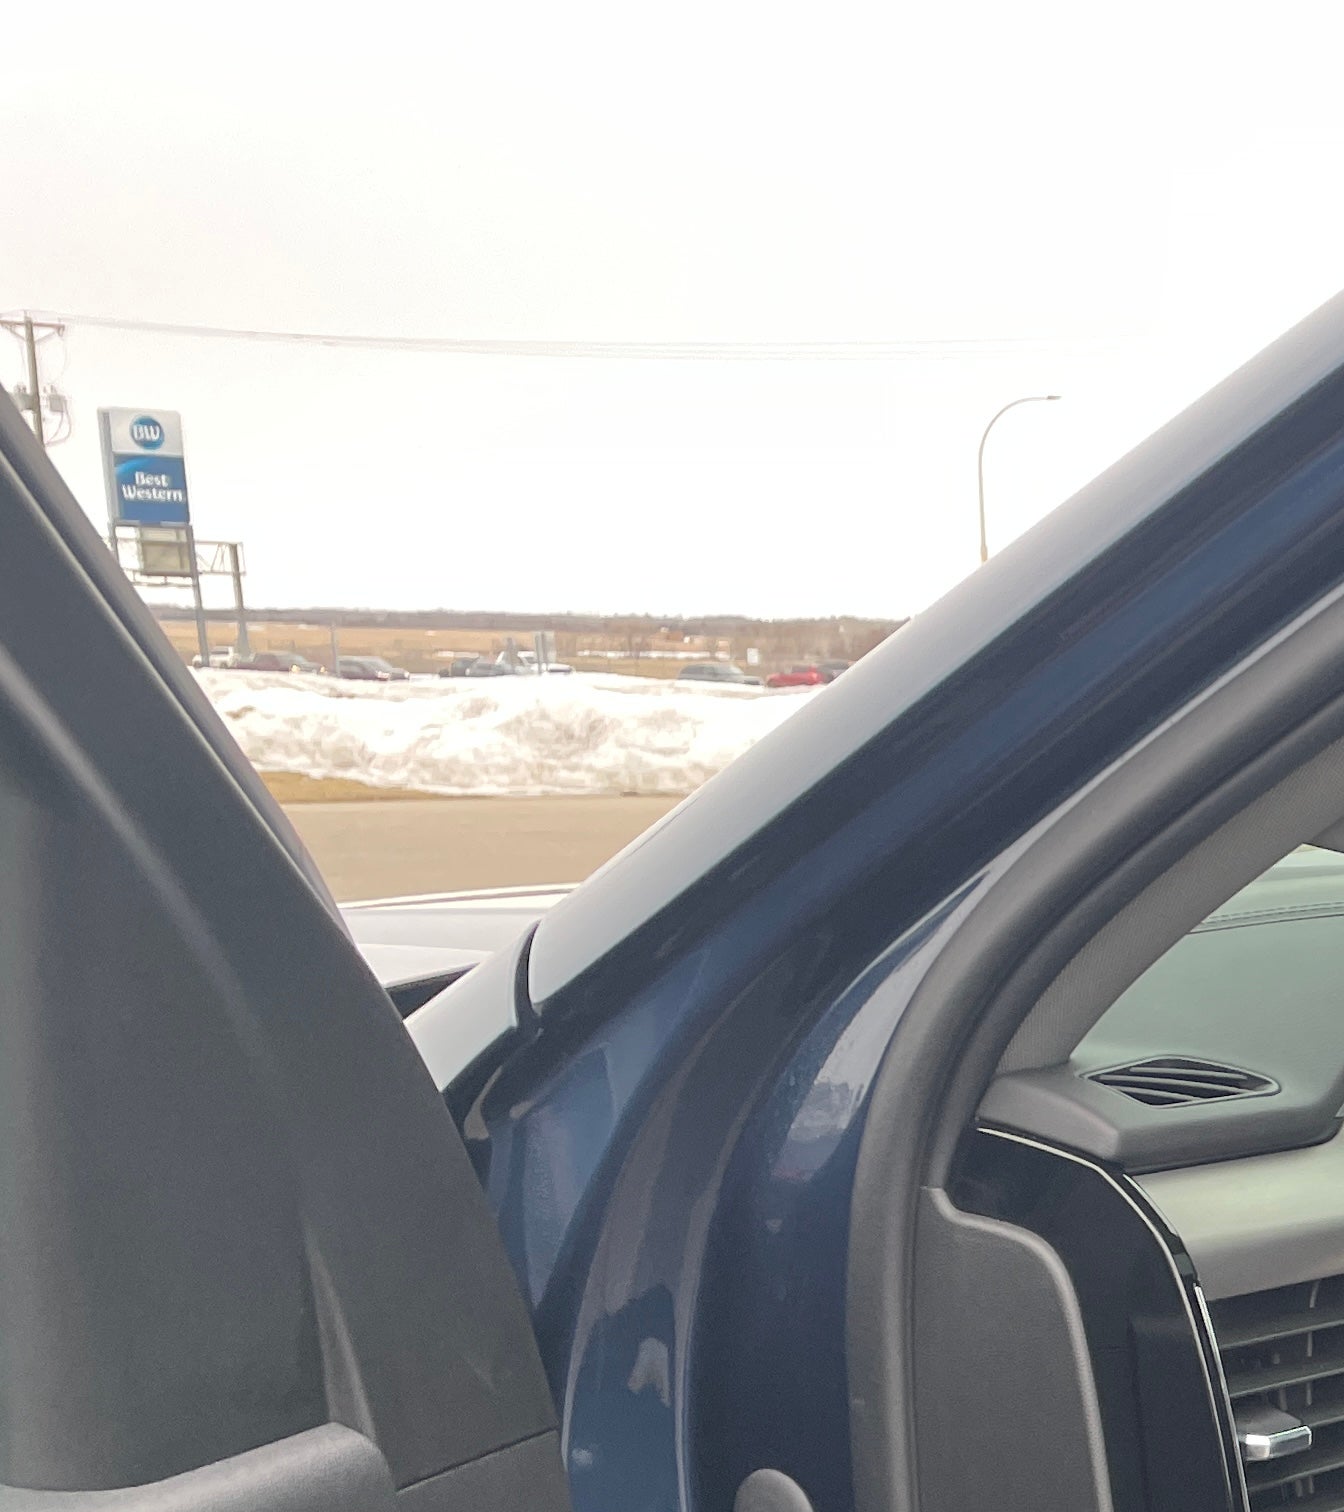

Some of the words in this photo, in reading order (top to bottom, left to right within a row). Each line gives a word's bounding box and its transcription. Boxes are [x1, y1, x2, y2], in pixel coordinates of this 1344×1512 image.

[132, 424, 161, 442] BW
[134, 471, 169, 488] Best
[121, 484, 184, 502] Western
